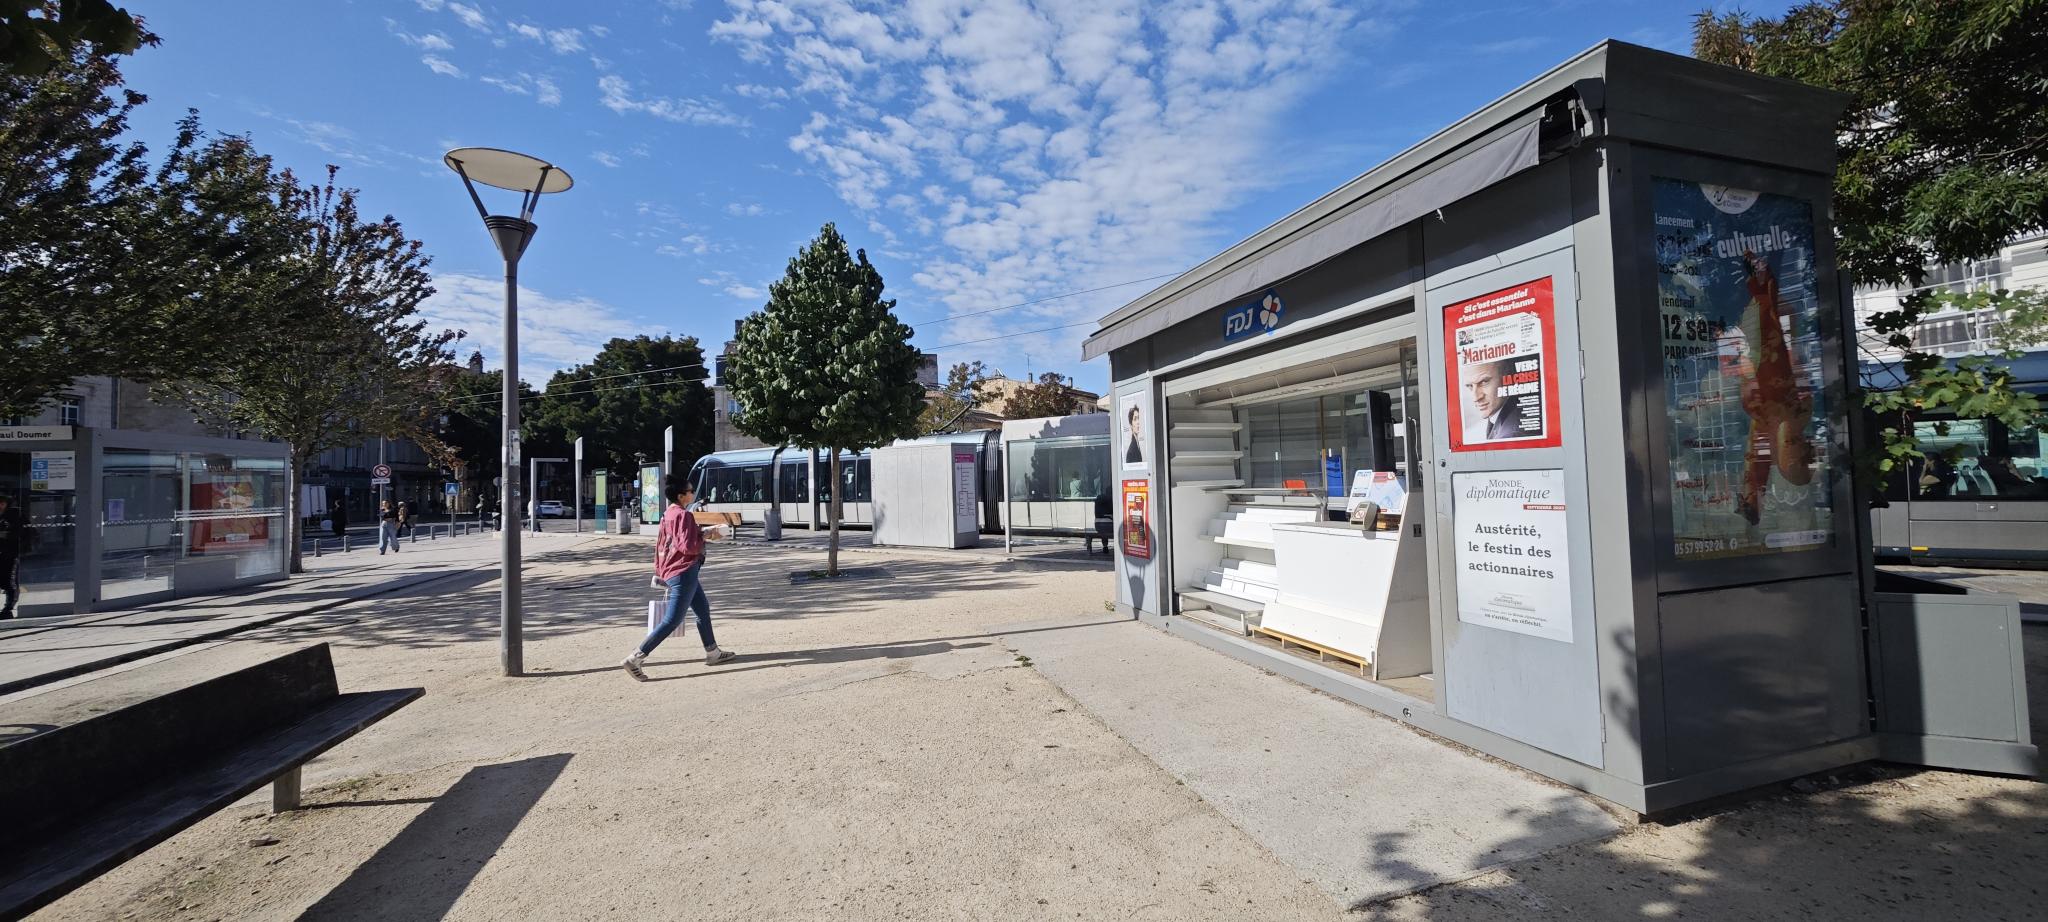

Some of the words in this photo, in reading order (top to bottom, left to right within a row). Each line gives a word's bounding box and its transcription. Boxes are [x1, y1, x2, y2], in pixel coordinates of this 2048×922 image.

[1655, 212, 1695, 229] Lancement
[1717, 224, 1790, 259] culturelle
[1464, 304, 1471, 314] Si
[1472, 300, 1490, 312] c'est
[1491, 288, 1528, 306] essentiel
[1458, 314, 1476, 324] c'est
[1476, 308, 1496, 319] dans
[1497, 298, 1535, 313] Marianne
[1226, 308, 1253, 336] FDJ
[1662, 314, 1681, 339] 12
[1463, 342, 1516, 364] Marianne
[1515, 359, 1538, 373] VERS
[1503, 374, 1513, 385] LA
[1513, 371, 1538, 383] CRISE
[1498, 386, 1508, 397] DE
[1508, 382, 1539, 396] RÉGIME
[0, 431, 14, 439] aul
[17, 430, 52, 438] Doumer
[1466, 484, 1550, 502] diplomatique
[1475, 523, 1542, 538] Austérité,
[1468, 541, 1480, 552] le
[1484, 542, 1523, 555] festin
[1527, 546, 1552, 558] des
[1468, 561, 1554, 579] actionnaires
